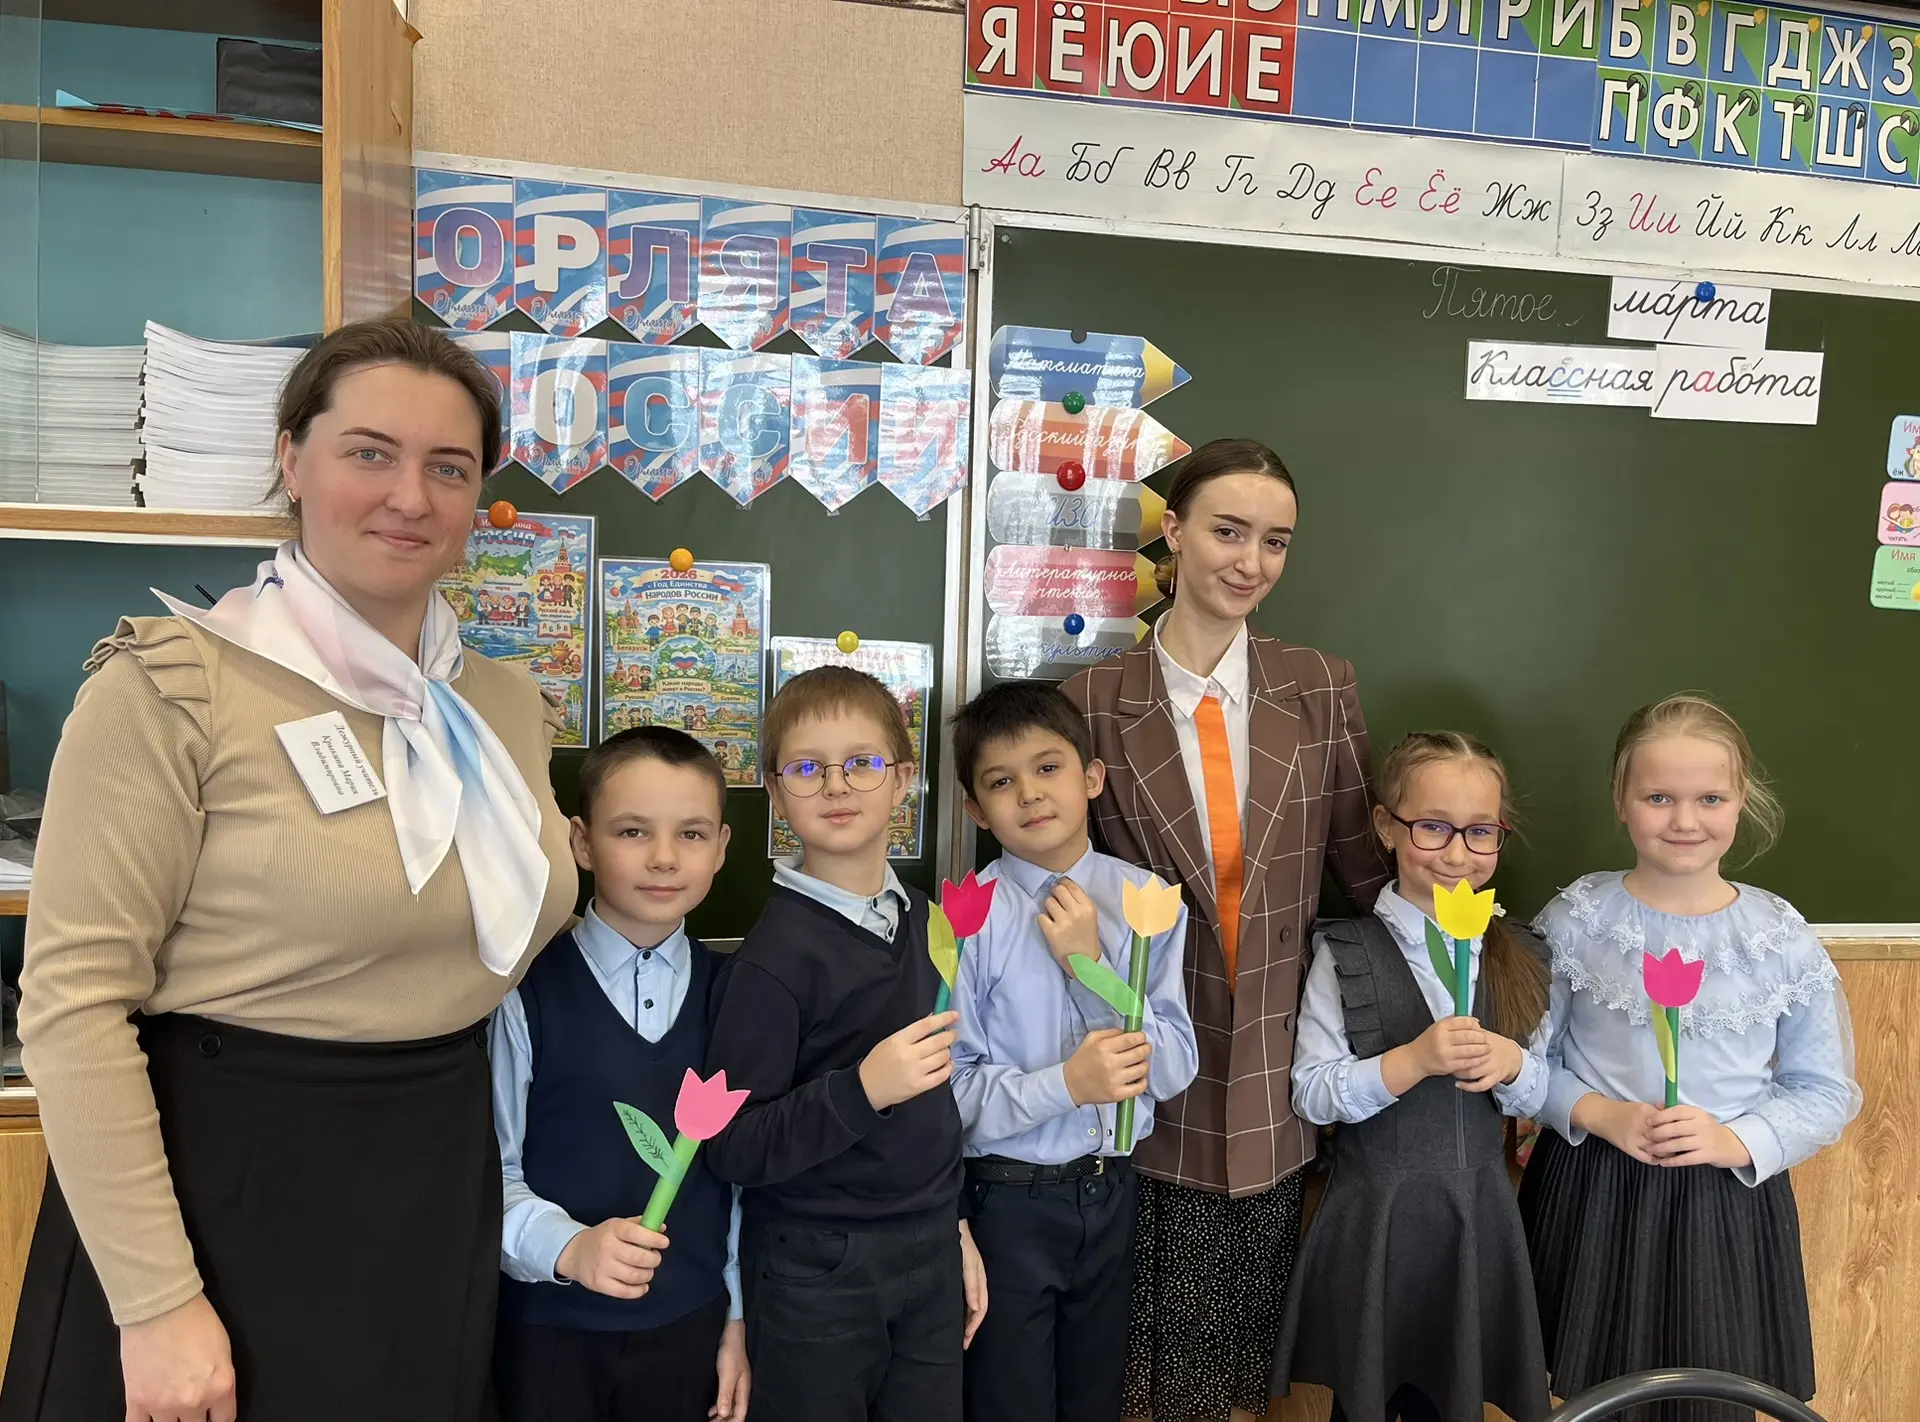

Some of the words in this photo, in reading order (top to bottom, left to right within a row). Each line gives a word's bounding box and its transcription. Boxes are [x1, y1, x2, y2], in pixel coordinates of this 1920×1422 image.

[977, 6, 1018, 77] Я
[1048, 2, 1087, 85] Ё
[1106, 18, 1167, 93] Ю
[1175, 25, 1225, 98] И
[1245, 33, 1284, 104] Е
[1609, 0, 1643, 59] Б
[1667, 5, 1698, 66] В
[1722, 12, 1756, 73] Г
[1767, 19, 1812, 91] Д
[1819, 25, 1870, 91] Ж
[1599, 78, 1638, 143] П
[1653, 87, 1700, 149] Ф
[1712, 94, 1752, 157] К
[1773, 101, 1805, 161] Т
[1815, 105, 1866, 169] Ш
[1876, 114, 1912, 176] С
[981, 134, 1045, 178] Аа
[1066, 141, 1134, 185] Бб
[1144, 147, 1198, 192] Вв
[1216, 154, 1260, 197] Гг
[1276, 162, 1336, 220] Дд
[1355, 167, 1398, 209] Ее
[1418, 169, 1461, 214] Ёё
[1482, 181, 1551, 222] Жж
[1576, 190, 1614, 241] Зз
[1629, 192, 1681, 235] Ии
[1695, 193, 1747, 242] Йй
[1760, 206, 1813, 247] Кк
[1825, 213, 1878, 252] Лл
[432, 206, 955, 327] ОРЛЯТА
[1423, 265, 1557, 322] Пятое
[1471, 349, 1654, 393] Классная
[489, 369, 960, 466] ОССИИ
[473, 529, 537, 549] РОССИЯ
[660, 569, 698, 580] 2026
[1891, 549, 1916, 561] Имя
